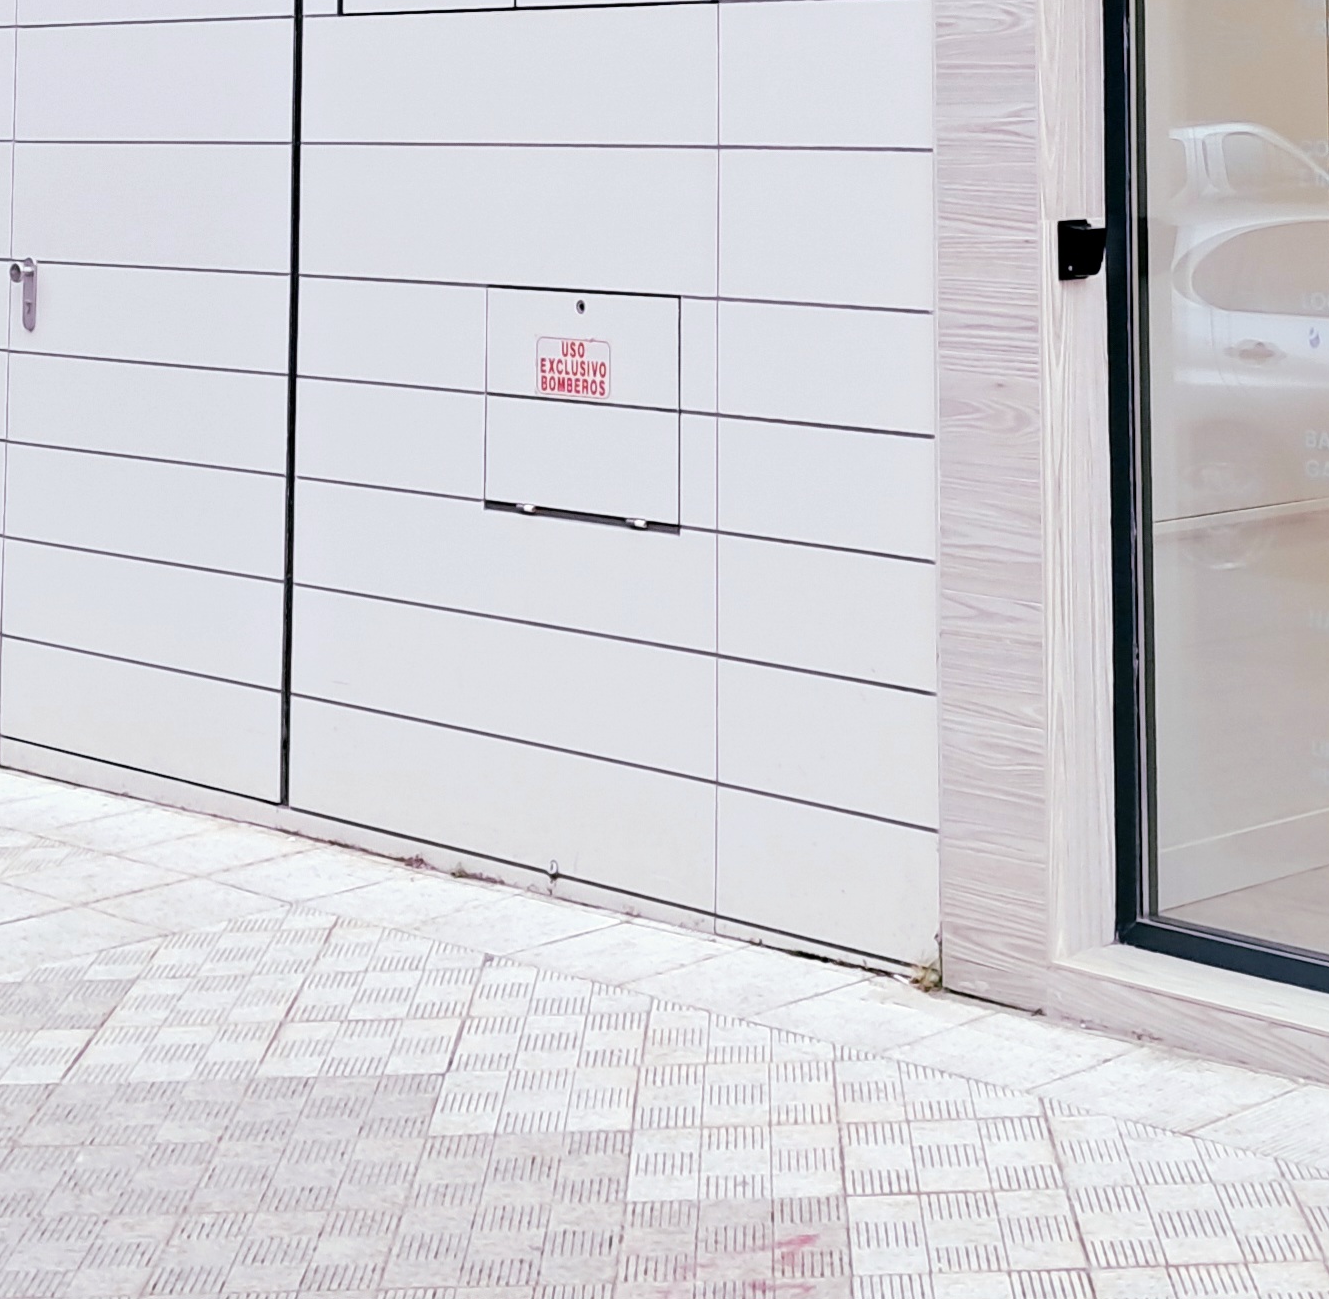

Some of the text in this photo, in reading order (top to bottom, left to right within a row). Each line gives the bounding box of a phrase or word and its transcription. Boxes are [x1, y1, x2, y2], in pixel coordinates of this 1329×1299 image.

[560, 340, 586, 358] USO
[540, 357, 607, 379] EXCLUSIVO
[540, 375, 606, 396] BOMBEROS
